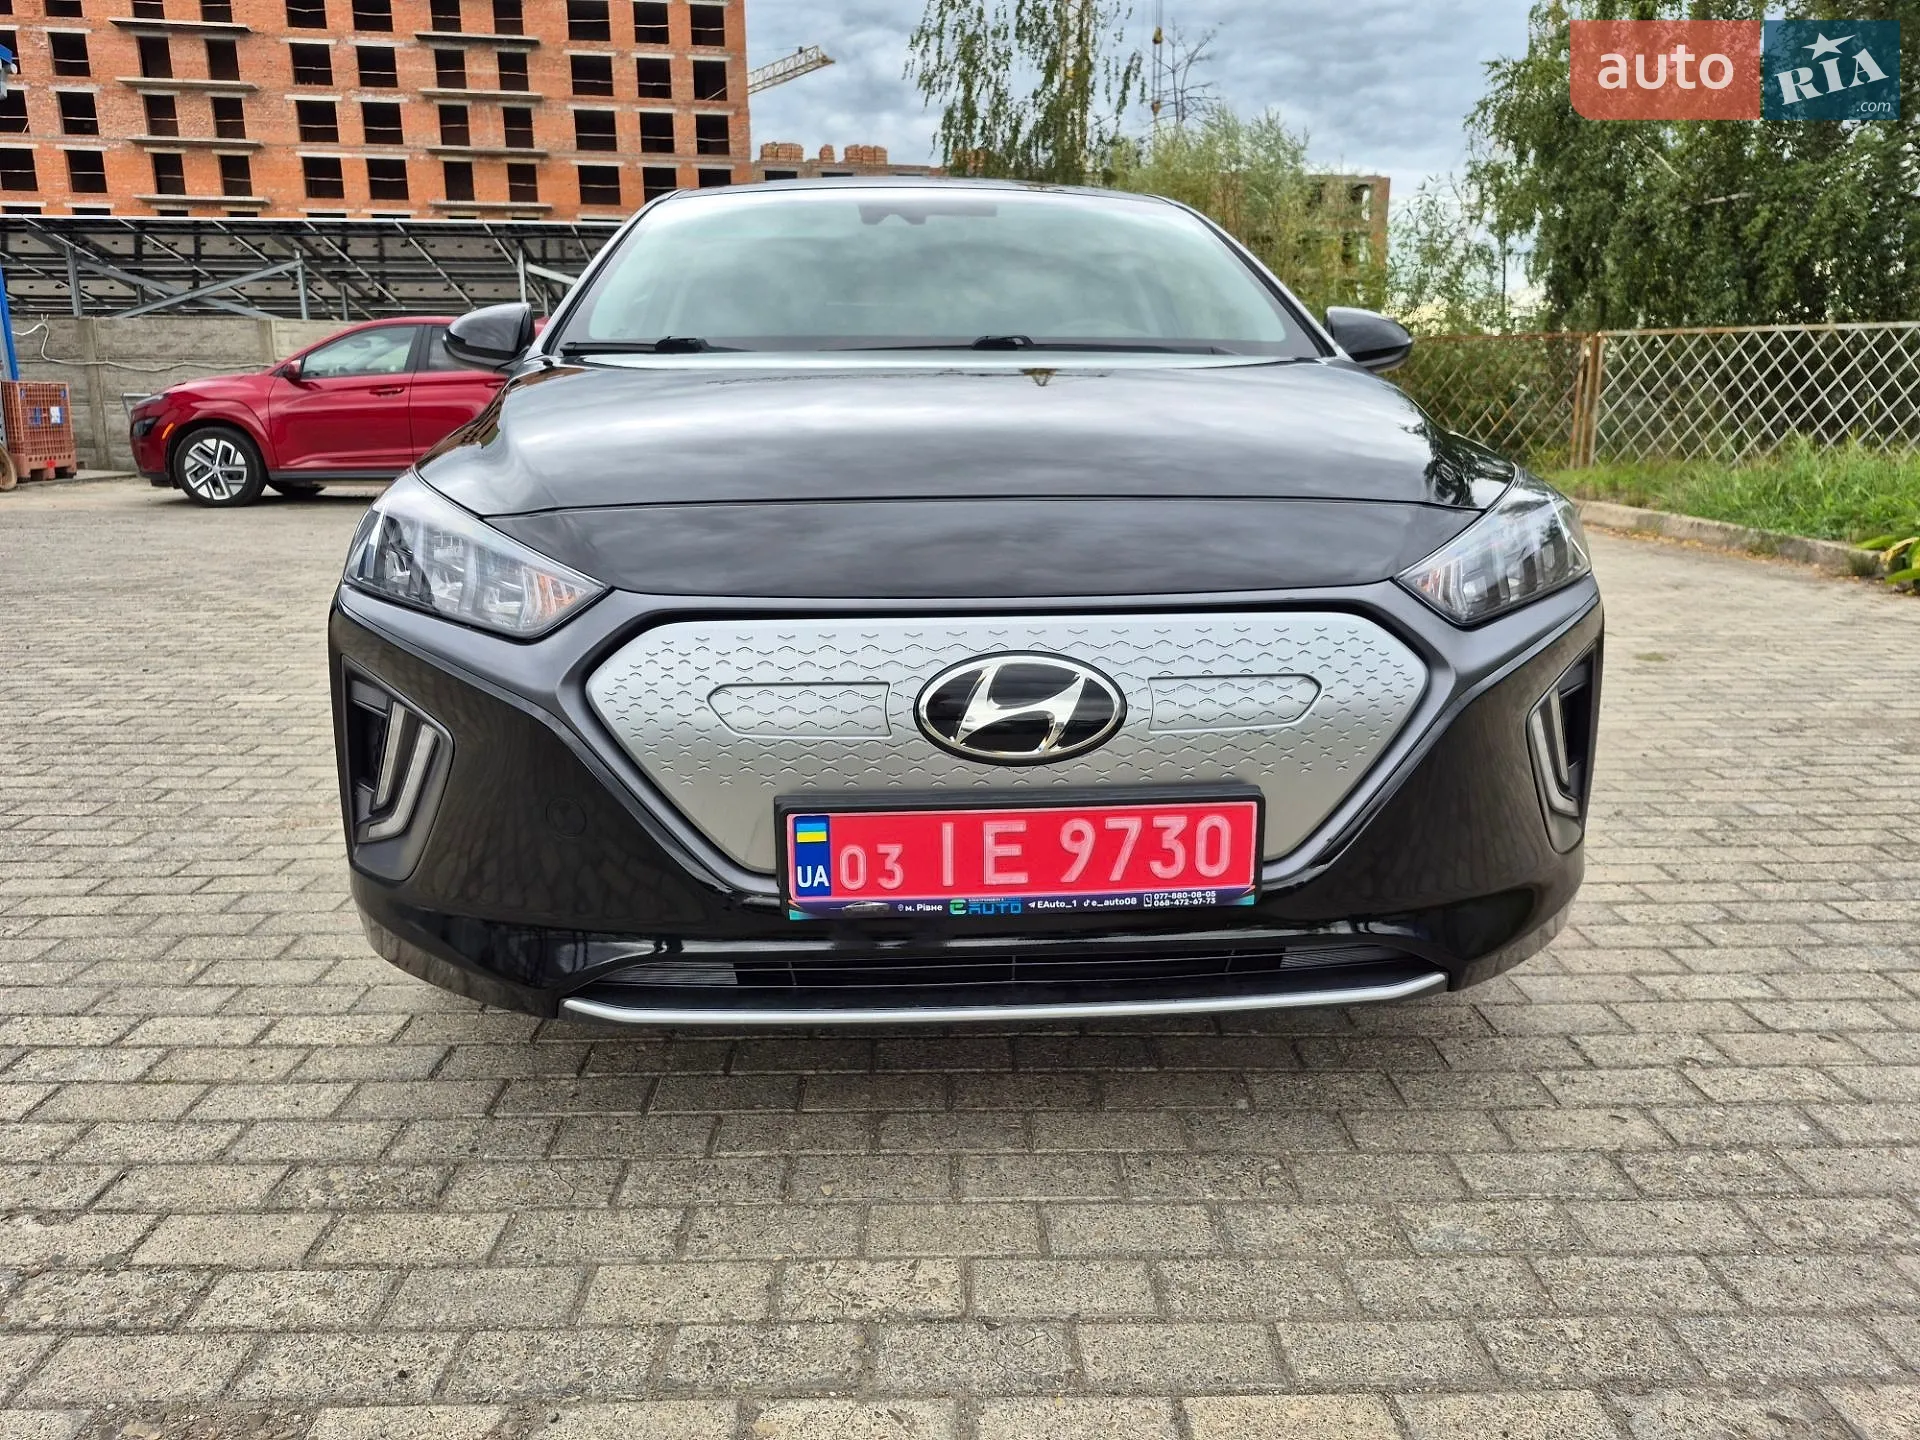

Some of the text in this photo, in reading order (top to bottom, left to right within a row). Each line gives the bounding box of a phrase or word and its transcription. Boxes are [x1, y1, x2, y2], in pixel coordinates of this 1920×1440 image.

[840, 814, 1232, 891] 03 IE 9730
[797, 865, 830, 888] UA
[1037, 899, 1077, 909] EAuto_1
[1091, 897, 1137, 907] e_auto08
[916, 903, 943, 913] Рівне
